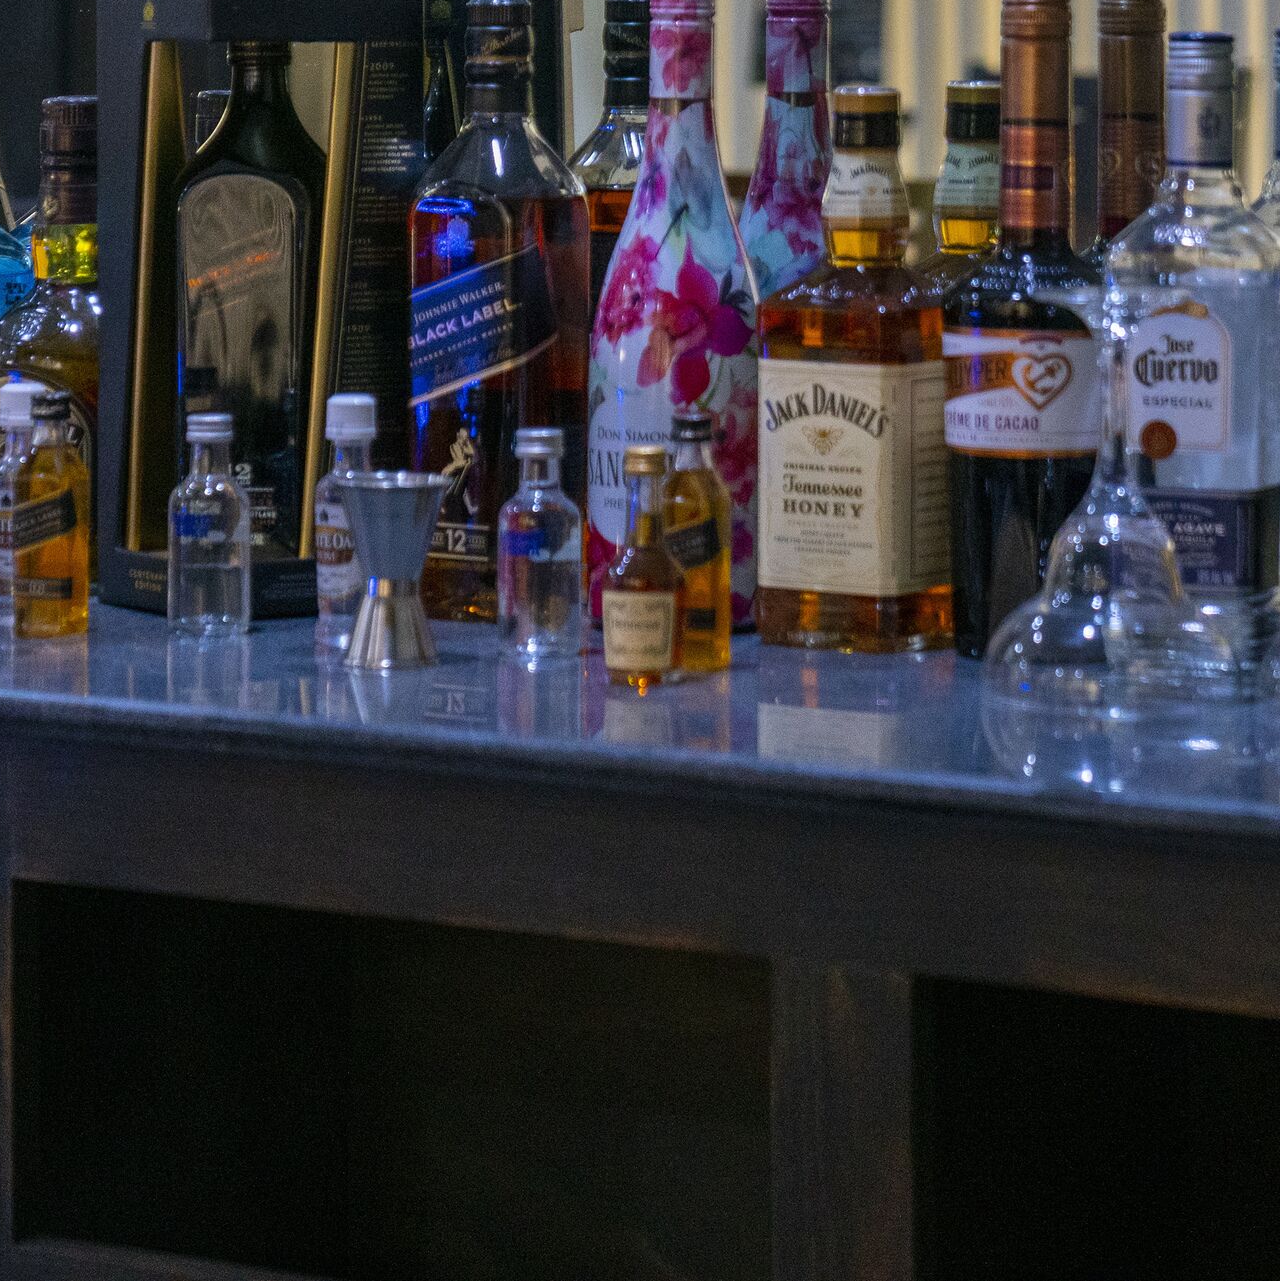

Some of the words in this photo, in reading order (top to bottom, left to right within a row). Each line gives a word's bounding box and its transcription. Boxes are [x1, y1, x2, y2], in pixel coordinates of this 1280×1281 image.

[413, 299, 459, 326] JOHNNIE
[458, 281, 504, 305] WALKER
[461, 296, 518, 329] LABEL
[946, 357, 1008, 391] UYPER
[1133, 346, 1219, 389] Cuervo
[764, 390, 811, 433] JACK
[811, 381, 890, 439] DANIEL'S
[1142, 395, 1213, 409] ESPECIAL
[974, 413, 990, 432] DE
[994, 415, 1040, 432] CACAO
[782, 473, 864, 498] Tennessee
[782, 497, 865, 519] HONEY
[445, 528, 467, 553] 12
